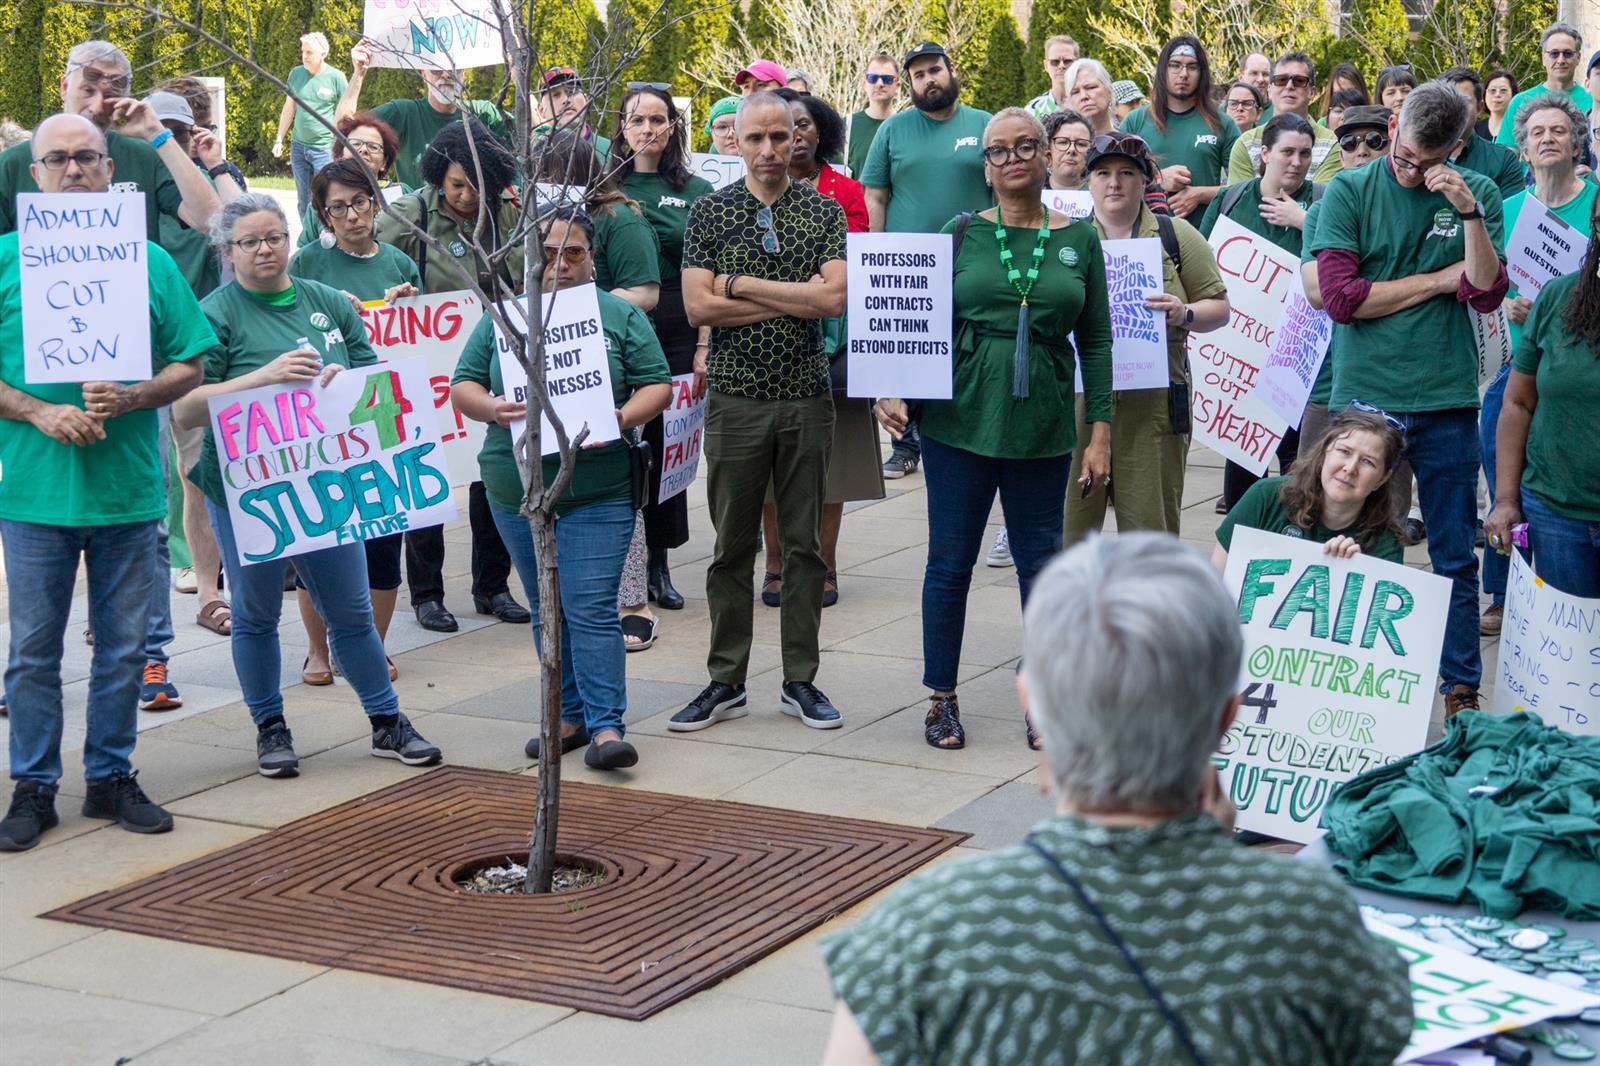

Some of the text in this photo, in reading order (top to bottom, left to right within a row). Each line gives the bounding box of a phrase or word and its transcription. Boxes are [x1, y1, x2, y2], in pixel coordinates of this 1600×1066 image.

[24, 203, 122, 233] ADMIN
[1053, 196, 1076, 213] OUR
[1537, 222, 1571, 253] ANSWER
[1542, 241, 1558, 260] THE
[22, 241, 142, 268] SHOULDN'T
[861, 252, 936, 268] PROFESSORS
[1216, 236, 1293, 303] CUT
[870, 274, 928, 289] WITH FAIR
[1106, 262, 1145, 281] RKING
[1107, 272, 1157, 293] ITIONS
[1511, 264, 1530, 280] STOP
[46, 280, 110, 310] CUT
[865, 296, 933, 311] CONTRACTS
[1113, 289, 1144, 303] OUR
[499, 318, 598, 353] URSITIES
[869, 318, 929, 333] CAN THINK
[1111, 314, 1155, 330] RNING
[1112, 327, 1159, 343] ITIONS
[1286, 305, 1328, 341] CONDITIONS
[1287, 320, 1318, 347] ARE OUR
[1488, 312, 1498, 339] OT
[38, 334, 119, 370] RUN
[553, 348, 582, 370] NOT
[851, 339, 949, 355] BEYOND DEFICITS
[1276, 343, 1313, 375] LEARNING
[1266, 352, 1311, 389] CONDITIONS
[513, 370, 602, 403] BNESSES
[1205, 372, 1248, 401] OUT
[218, 387, 327, 462] FAIR
[1207, 398, 1282, 463] HEART
[224, 427, 369, 489] CONTRACTS
[663, 428, 700, 473] FAIR
[336, 511, 409, 544] FUTURE
[1511, 556, 1537, 610] HOW
[1237, 558, 1414, 656] FAIR
[1539, 630, 1573, 662] YOU
[1248, 645, 1421, 705] ONTRACT
[1503, 661, 1540, 707] PEOPLE
[1560, 705, 1588, 725] TO
[1239, 682, 1376, 744] 4 OUR
